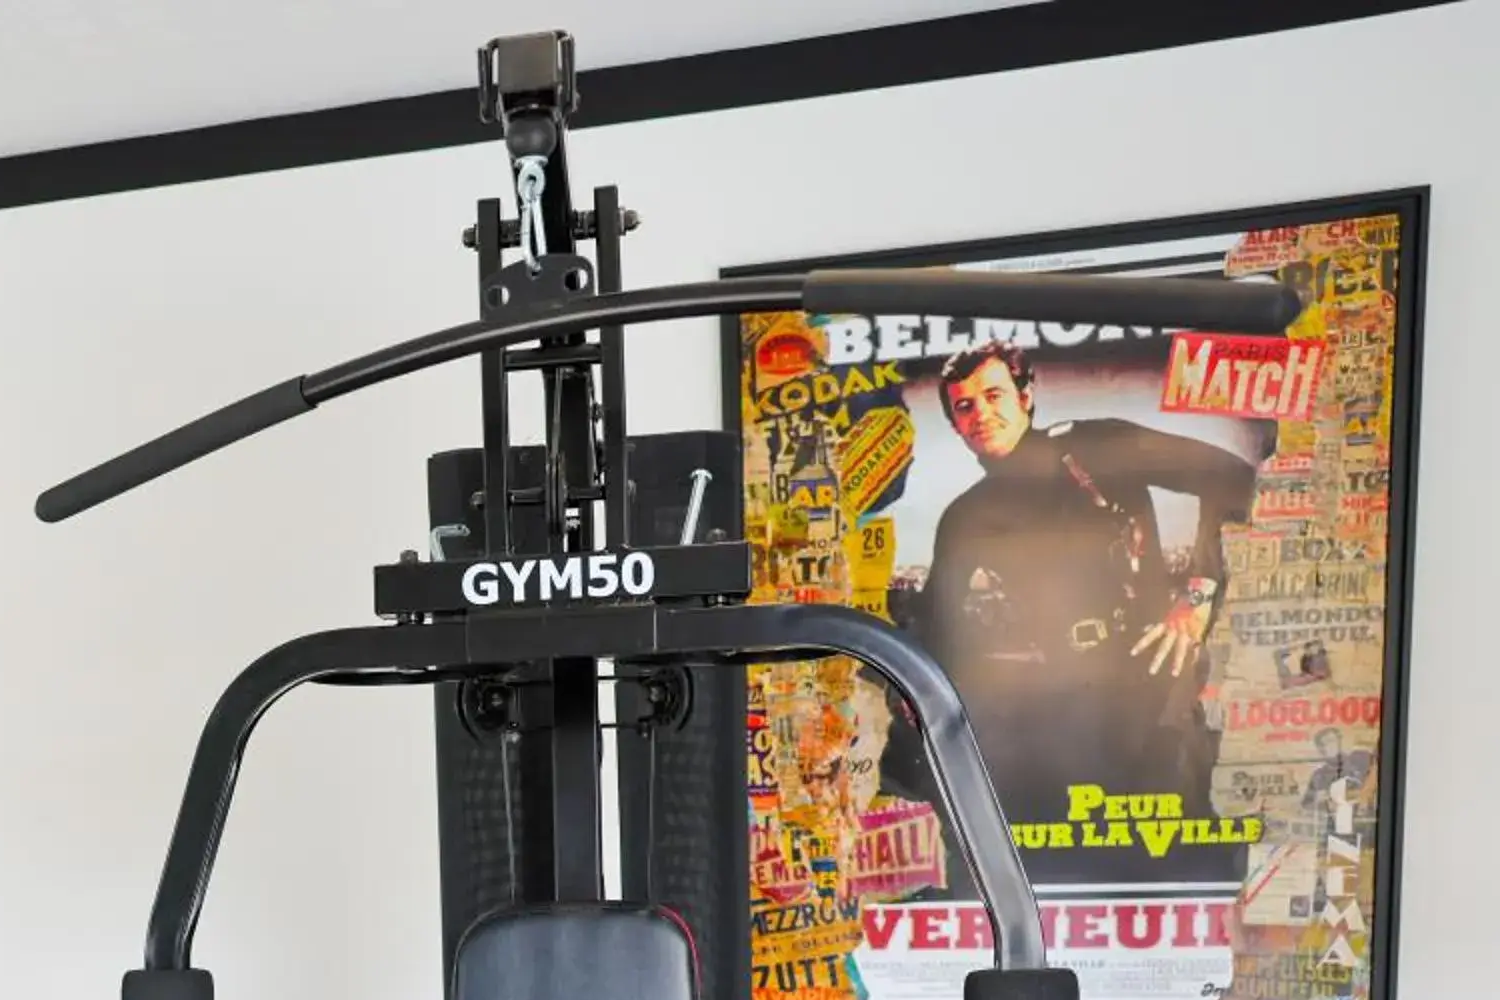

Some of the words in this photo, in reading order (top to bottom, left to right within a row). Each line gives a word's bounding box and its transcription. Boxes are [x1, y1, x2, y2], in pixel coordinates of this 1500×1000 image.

[755, 359, 906, 424] KODAK
[1164, 337, 1322, 418] MATCH
[862, 527, 886, 552] 26
[461, 551, 655, 605] GYM50
[1067, 784, 1183, 821] PEUR
[1082, 821, 1134, 848] LA
[1135, 817, 1265, 858] VILLE
